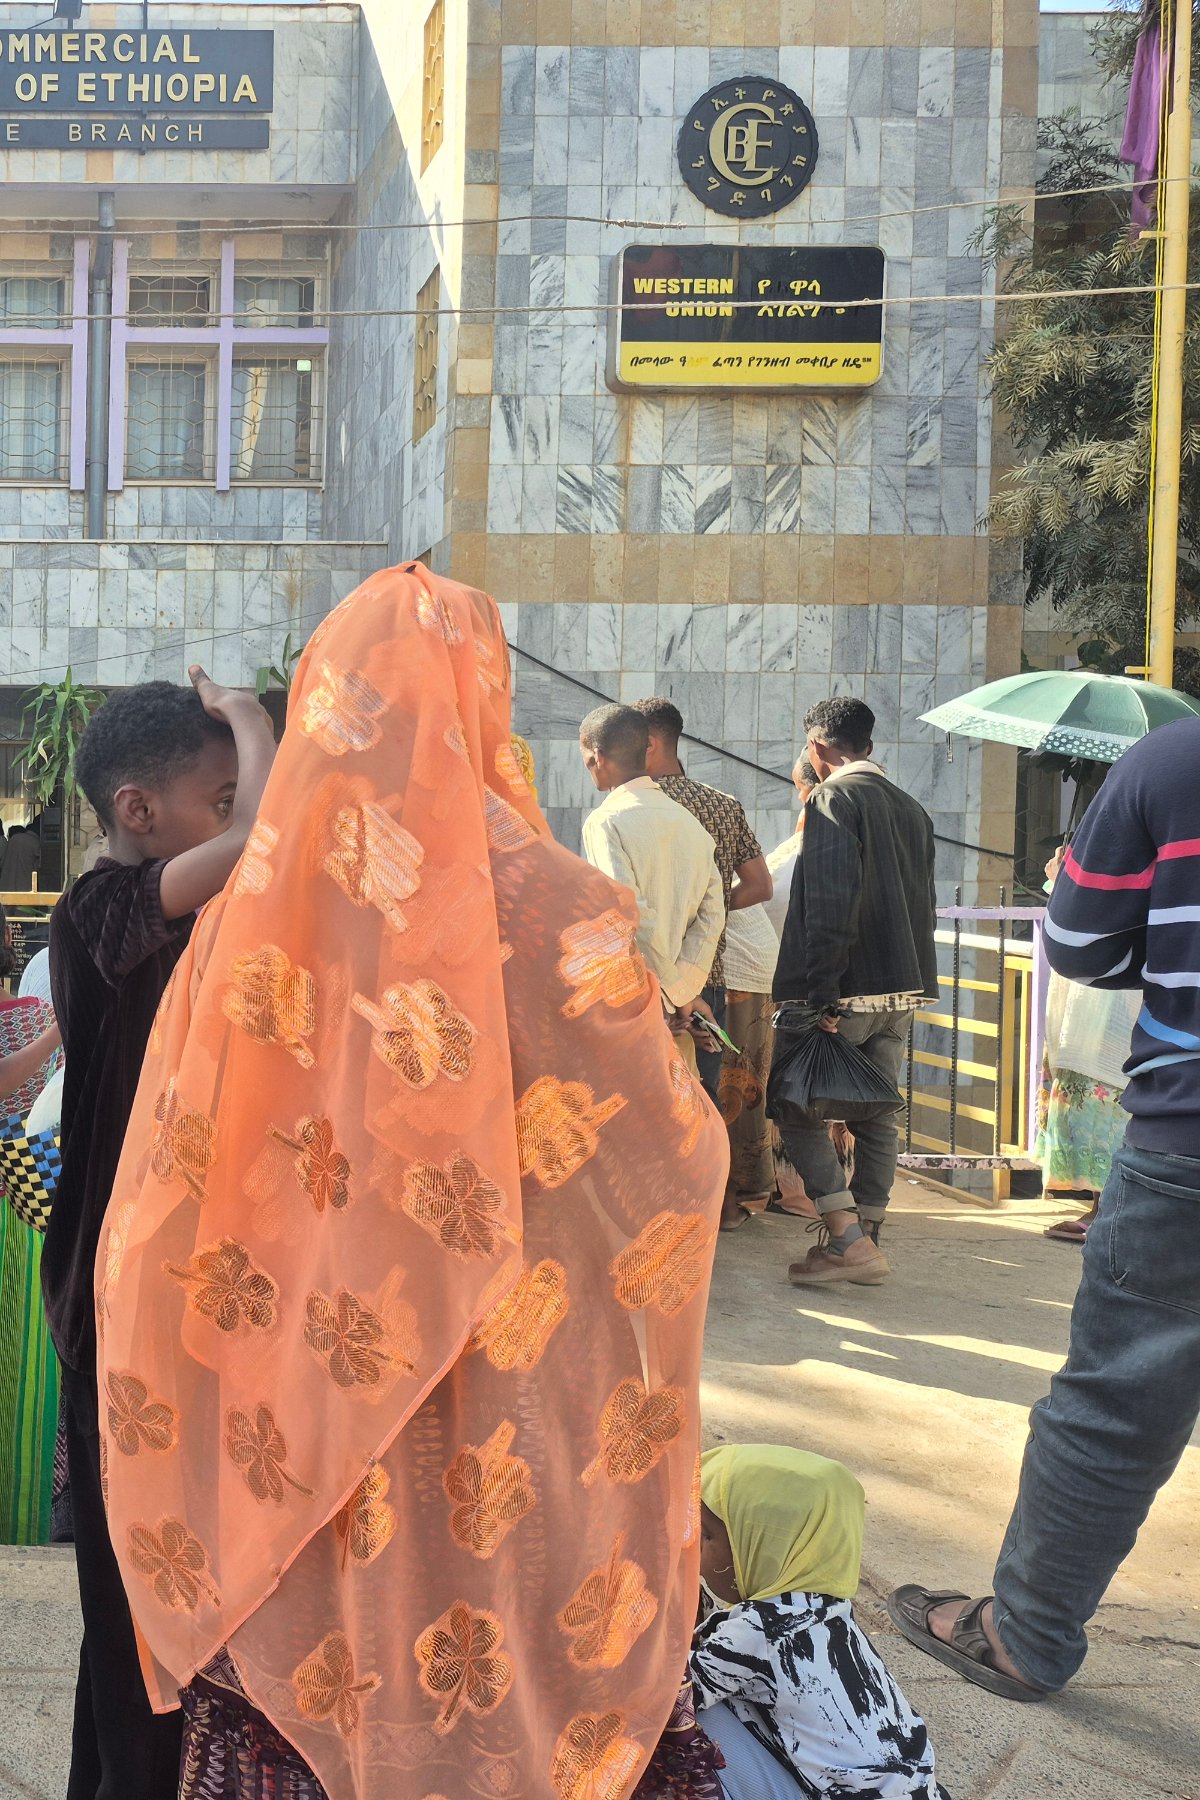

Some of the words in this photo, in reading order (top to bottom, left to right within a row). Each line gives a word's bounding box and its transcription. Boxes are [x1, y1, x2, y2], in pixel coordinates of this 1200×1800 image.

[15, 73, 59, 102] OF
[77, 73, 258, 103] ETHIOPIA
[68, 123, 203, 142] BRANCH
[633, 278, 734, 295] WESTERN
[665, 300, 733, 317] UNION
